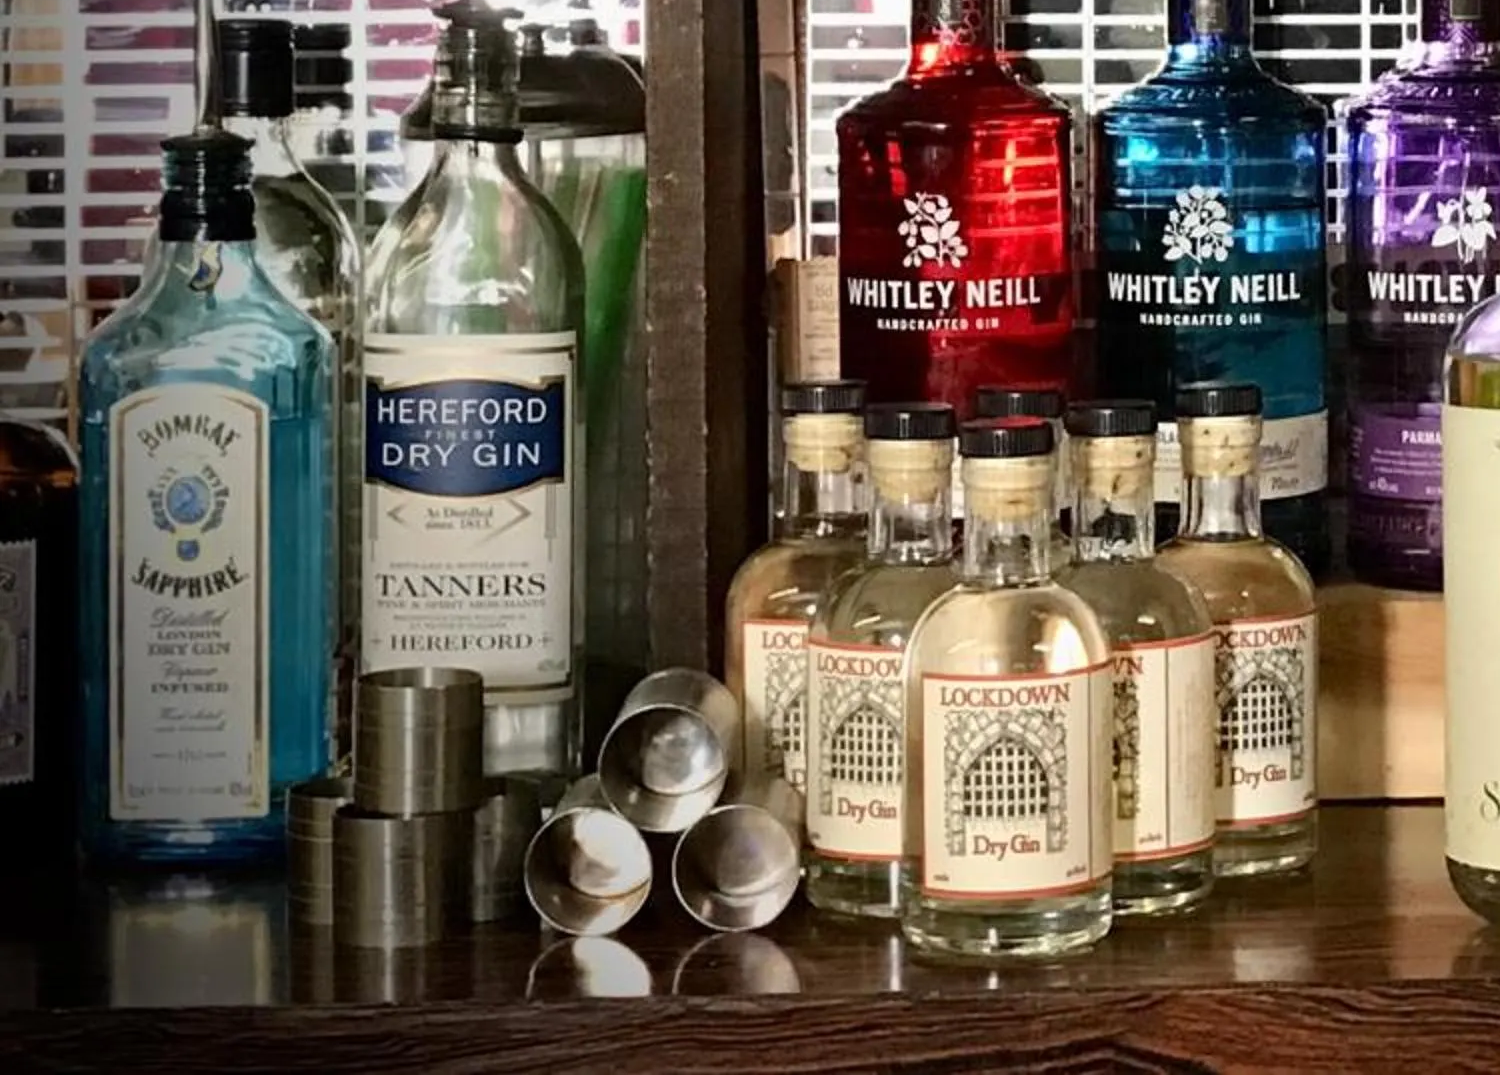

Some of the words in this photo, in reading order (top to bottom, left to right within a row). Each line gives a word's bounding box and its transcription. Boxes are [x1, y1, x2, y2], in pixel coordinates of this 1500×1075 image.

[847, 277, 955, 310] WHITLEY
[966, 276, 1041, 308] NEILL
[1107, 271, 1223, 304] WHITLEY
[1231, 271, 1301, 303] NEILL
[1368, 271, 1485, 303] WHITLEY
[876, 317, 969, 331] HANDCRAFTED
[975, 317, 999, 330] GIN
[1139, 312, 1233, 326] HANDCRAFTED
[1239, 312, 1262, 325] GIN
[1403, 311, 1465, 324] HANDCRA
[377, 398, 547, 424] HEREFORD
[137, 414, 242, 457] BOMBAY
[424, 429, 498, 442] FINEST
[1401, 430, 1442, 444] PARMA
[382, 443, 456, 468] DRY
[472, 442, 542, 467] GIN
[130, 556, 250, 599] SAPPHIRE
[375, 573, 547, 599] TANNERS
[390, 633, 534, 652] HEREFORD
[1215, 624, 1307, 649] OCKDOWN
[817, 653, 903, 677] LOCKDO
[150, 682, 230, 694] INFUSED
[940, 682, 1071, 708] LOCKDOWN
[1230, 766, 1262, 791] Dry
[1263, 765, 1288, 783] Gin
[837, 796, 867, 824] Dry
[868, 798, 898, 820] Gin
[972, 834, 1009, 862] Dry
[1010, 834, 1041, 854] Gin
